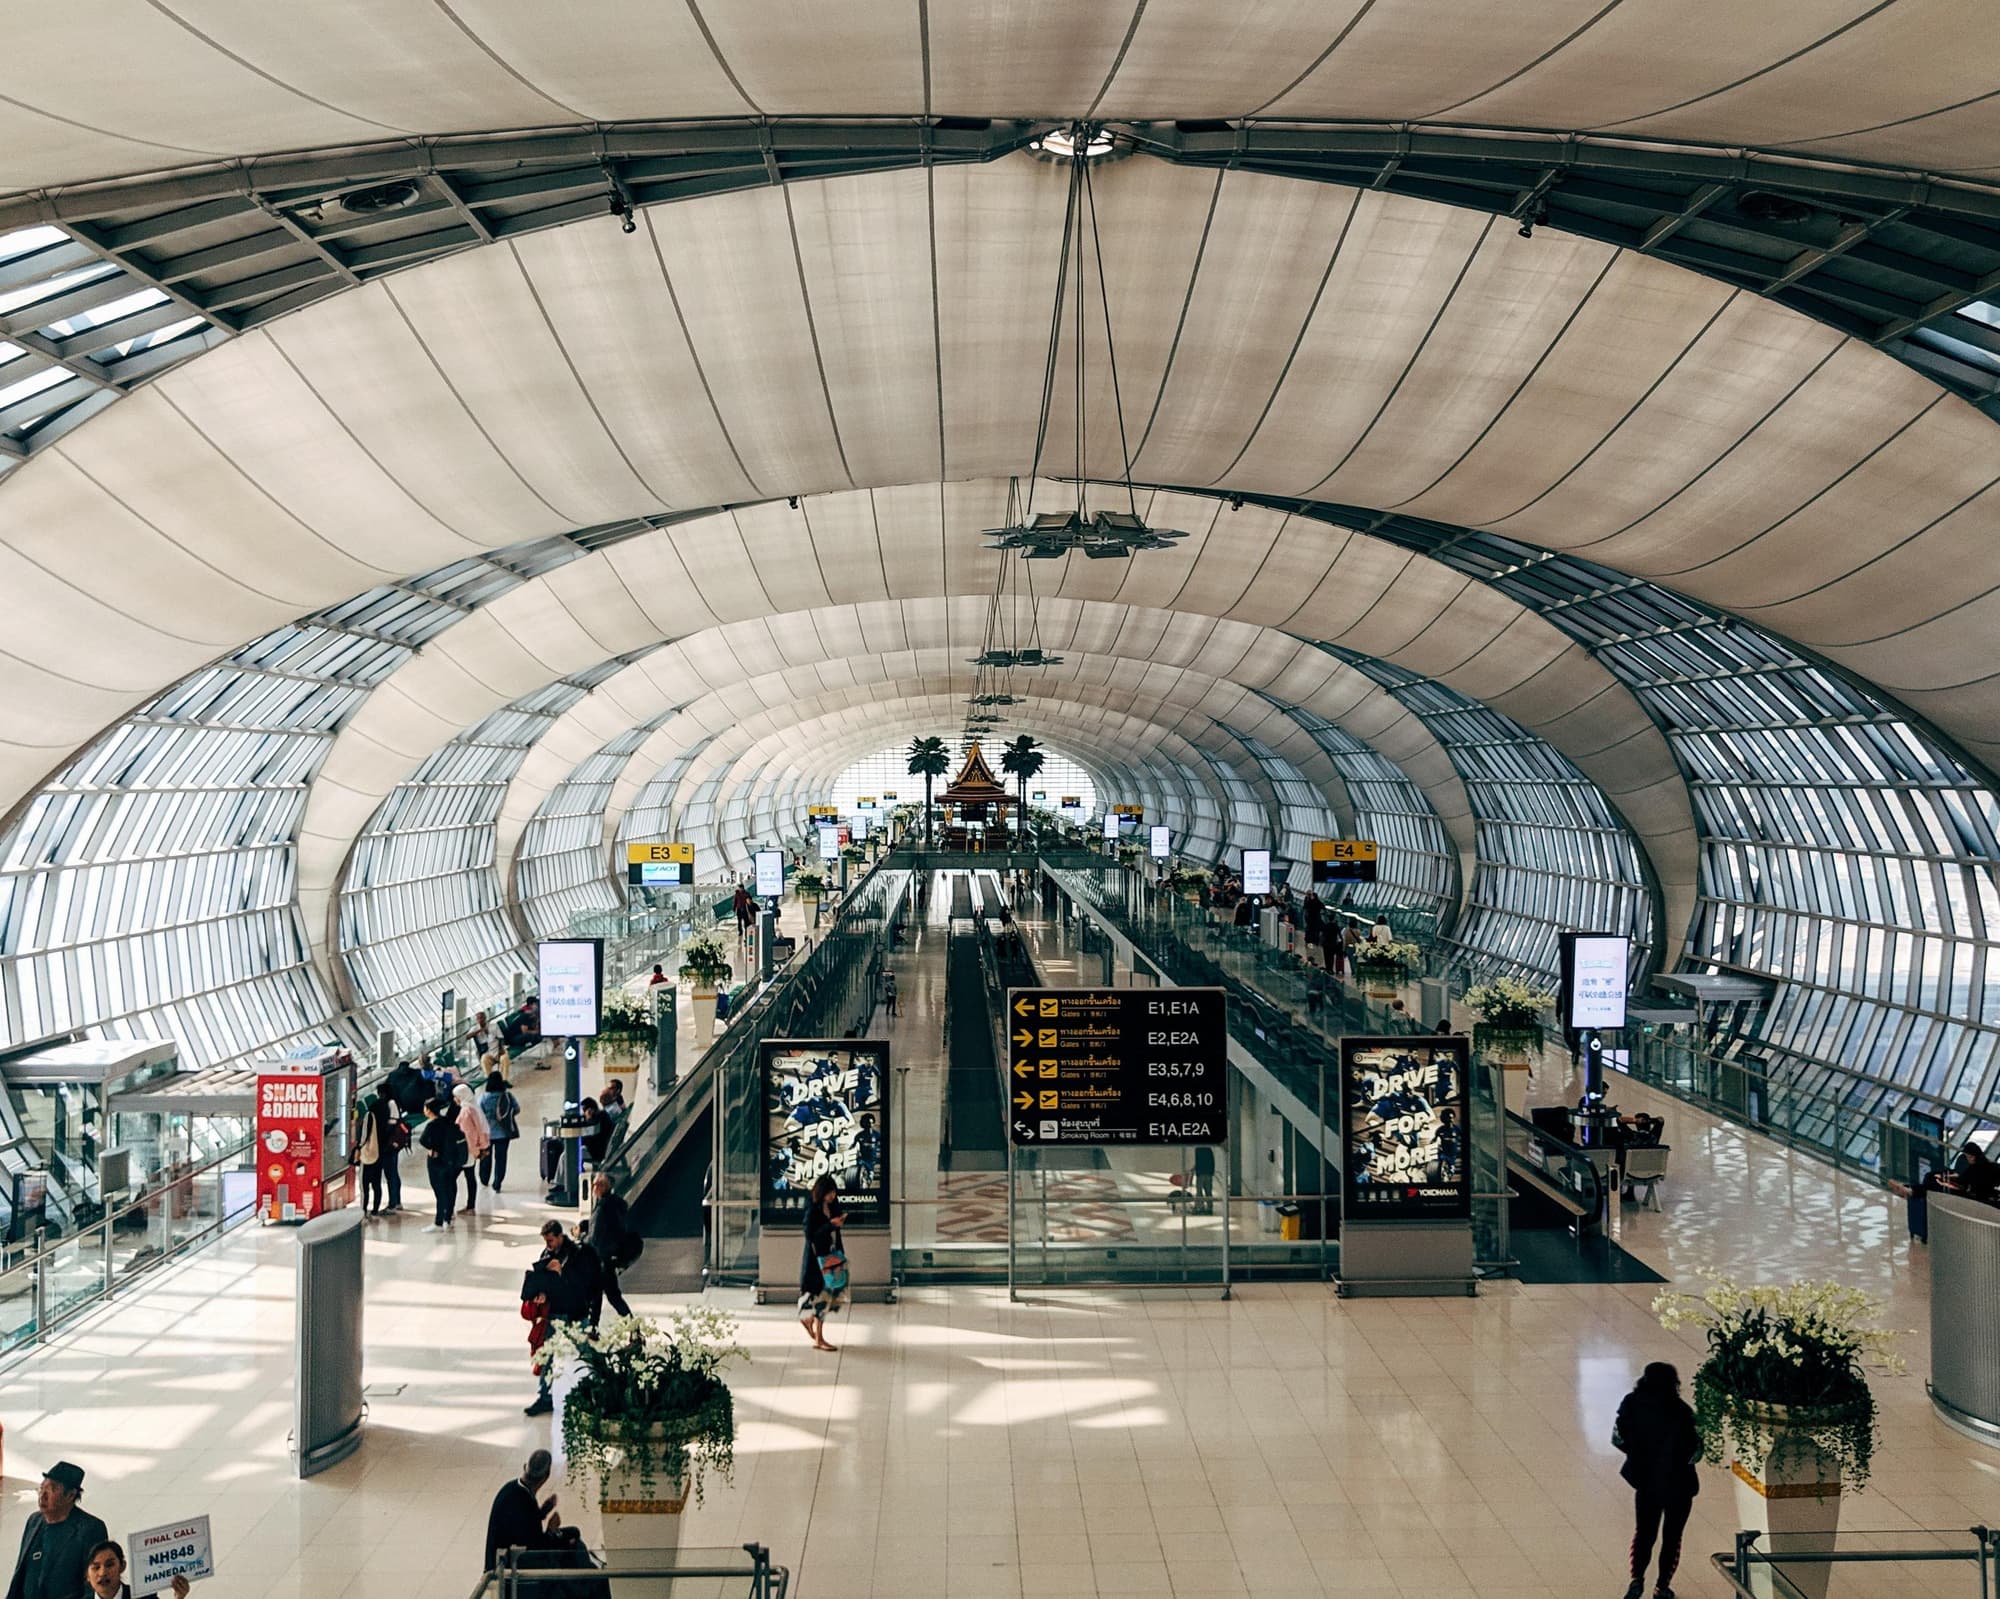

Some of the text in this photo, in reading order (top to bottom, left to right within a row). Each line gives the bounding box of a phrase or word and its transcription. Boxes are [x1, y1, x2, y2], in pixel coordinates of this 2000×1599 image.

[650, 847, 671, 860] E3
[1334, 844, 1354, 857] E4
[1148, 1002, 1200, 1016] E1,E1A
[1148, 1032, 1199, 1046] E2,E2A
[1148, 1063, 1205, 1077] E3,5,7,9
[789, 1068, 859, 1105] DRIVE
[1372, 1064, 1439, 1100] DRIVE
[263, 1083, 318, 1102] SNACK
[1148, 1093, 1213, 1107] E4,6,8,10
[262, 1103, 318, 1119] &DRINK
[803, 1116, 850, 1144] FOR
[1149, 1123, 1210, 1136] E1A,E2A
[1384, 1112, 1431, 1139] FOR
[794, 1149, 858, 1182] MORE
[1376, 1144, 1439, 1176] MORE
[837, 1195, 877, 1203] YOKOHAMA
[1418, 1188, 1458, 1196] YOKOHAMA
[144, 1527, 197, 1546] FINAL CALL
[149, 1544, 195, 1566] NH848
